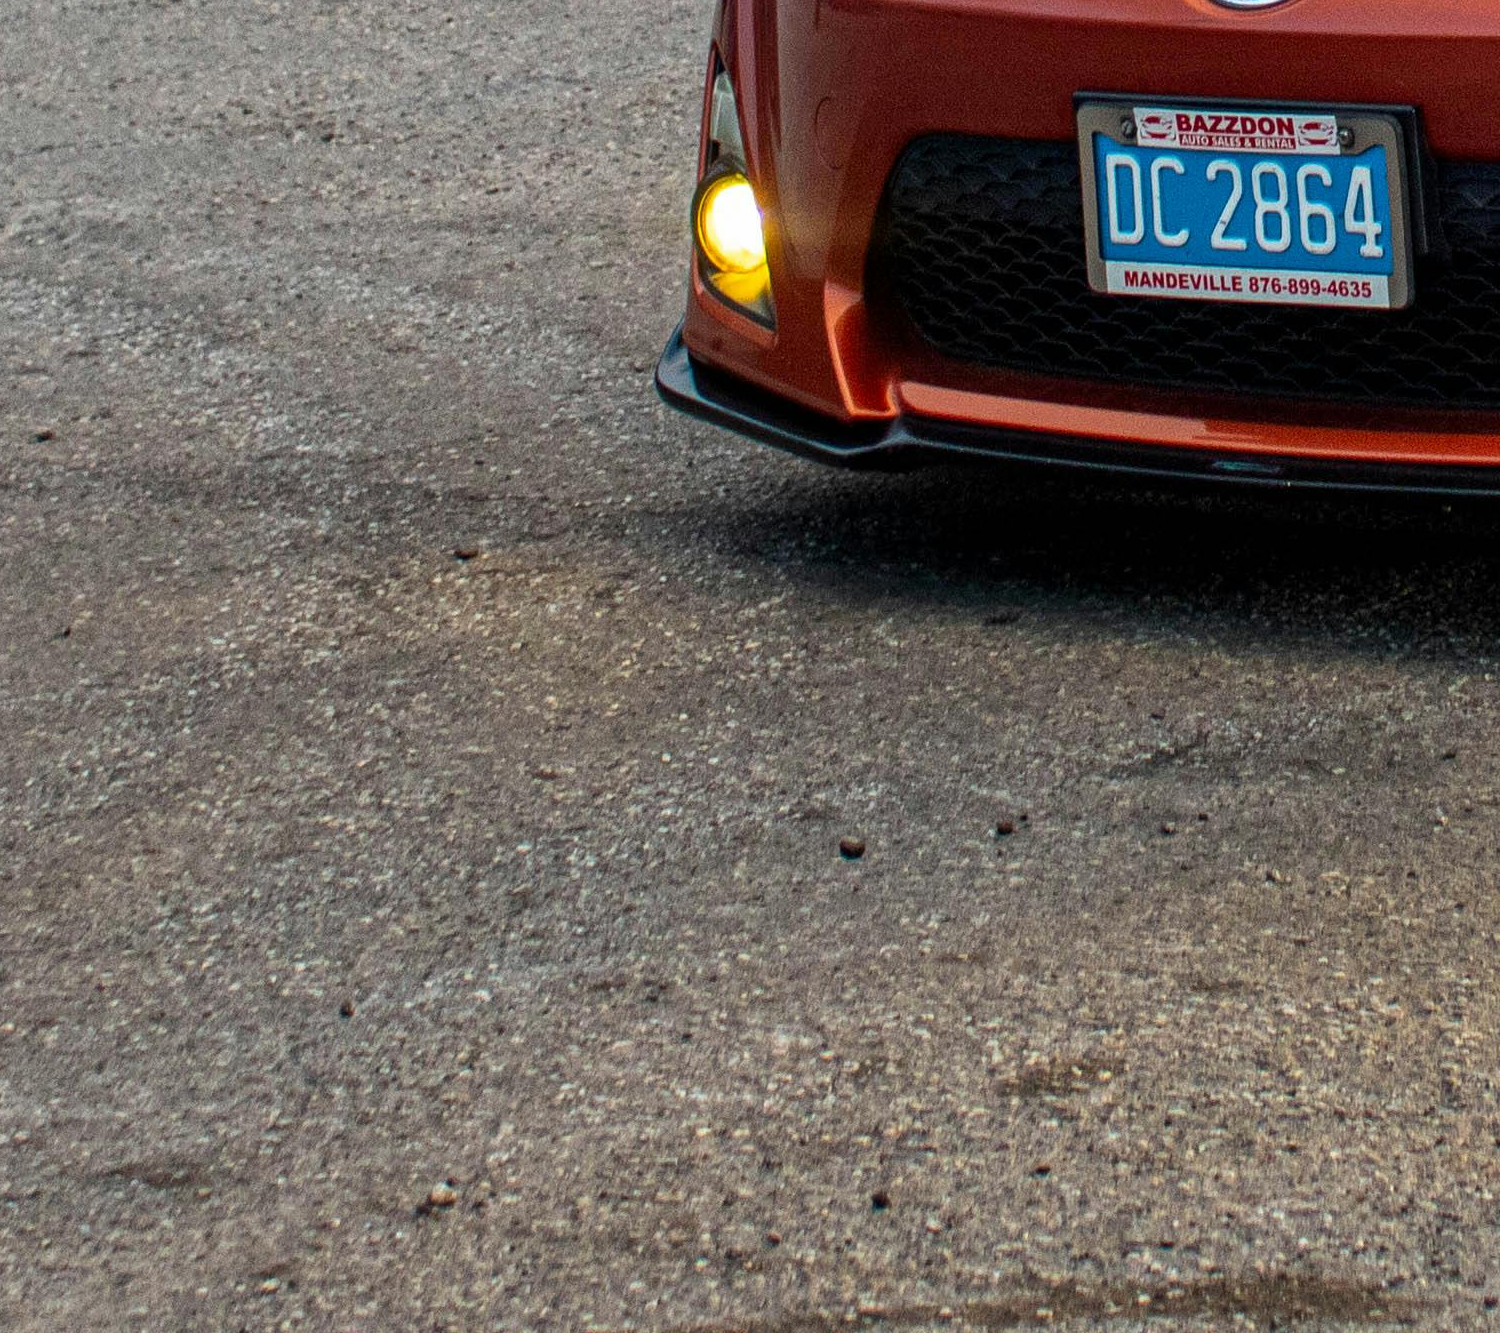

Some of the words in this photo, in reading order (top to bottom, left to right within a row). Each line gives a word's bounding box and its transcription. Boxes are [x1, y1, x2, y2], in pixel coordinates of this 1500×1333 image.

[1175, 113, 1295, 136] BAZZDON
[1181, 135, 1210, 146] AUTO
[1211, 135, 1241, 148] SALES
[1244, 137, 1251, 148] &
[1254, 137, 1295, 149] RENTAL
[1105, 153, 1190, 247] DC
[1206, 159, 1384, 258] 2864
[1124, 271, 1243, 293] MANDEVILLE
[1248, 275, 1372, 298] 876-899-4635
